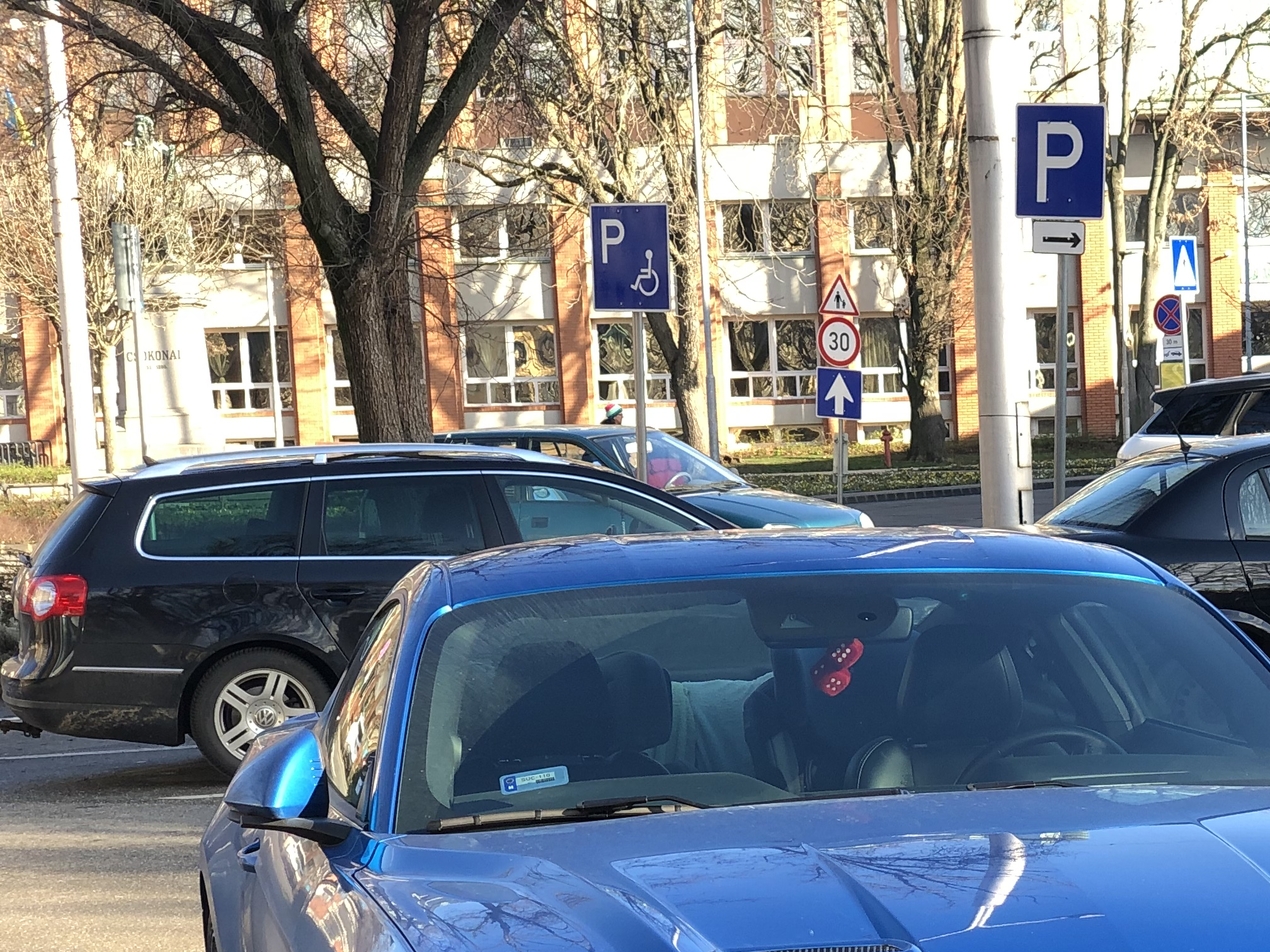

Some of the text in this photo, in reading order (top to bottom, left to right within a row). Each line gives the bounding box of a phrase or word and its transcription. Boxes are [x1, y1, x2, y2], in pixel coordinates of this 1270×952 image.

[1036, 121, 1084, 203] P
[601, 218, 625, 264] P
[828, 331, 850, 352] 30
